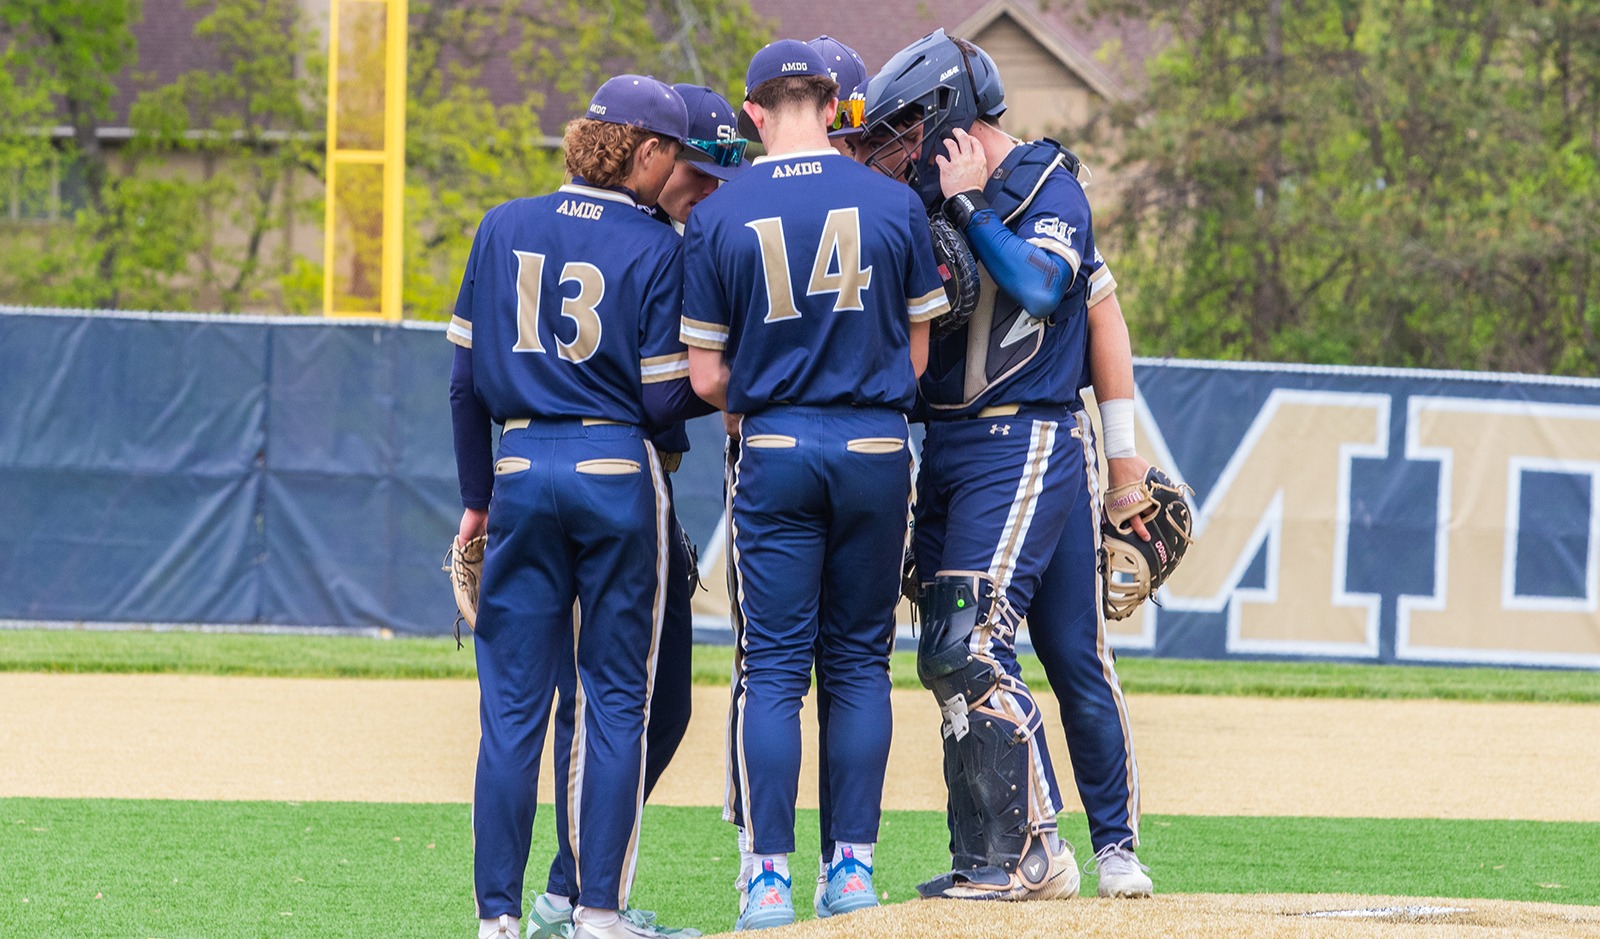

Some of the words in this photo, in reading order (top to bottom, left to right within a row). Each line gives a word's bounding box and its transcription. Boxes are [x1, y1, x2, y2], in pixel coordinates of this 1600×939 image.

[781, 62, 808, 72] AMDG
[772, 161, 822, 178] AMDG
[556, 200, 604, 221] AMDG
[744, 207, 873, 324] 14
[511, 249, 605, 365] 13
